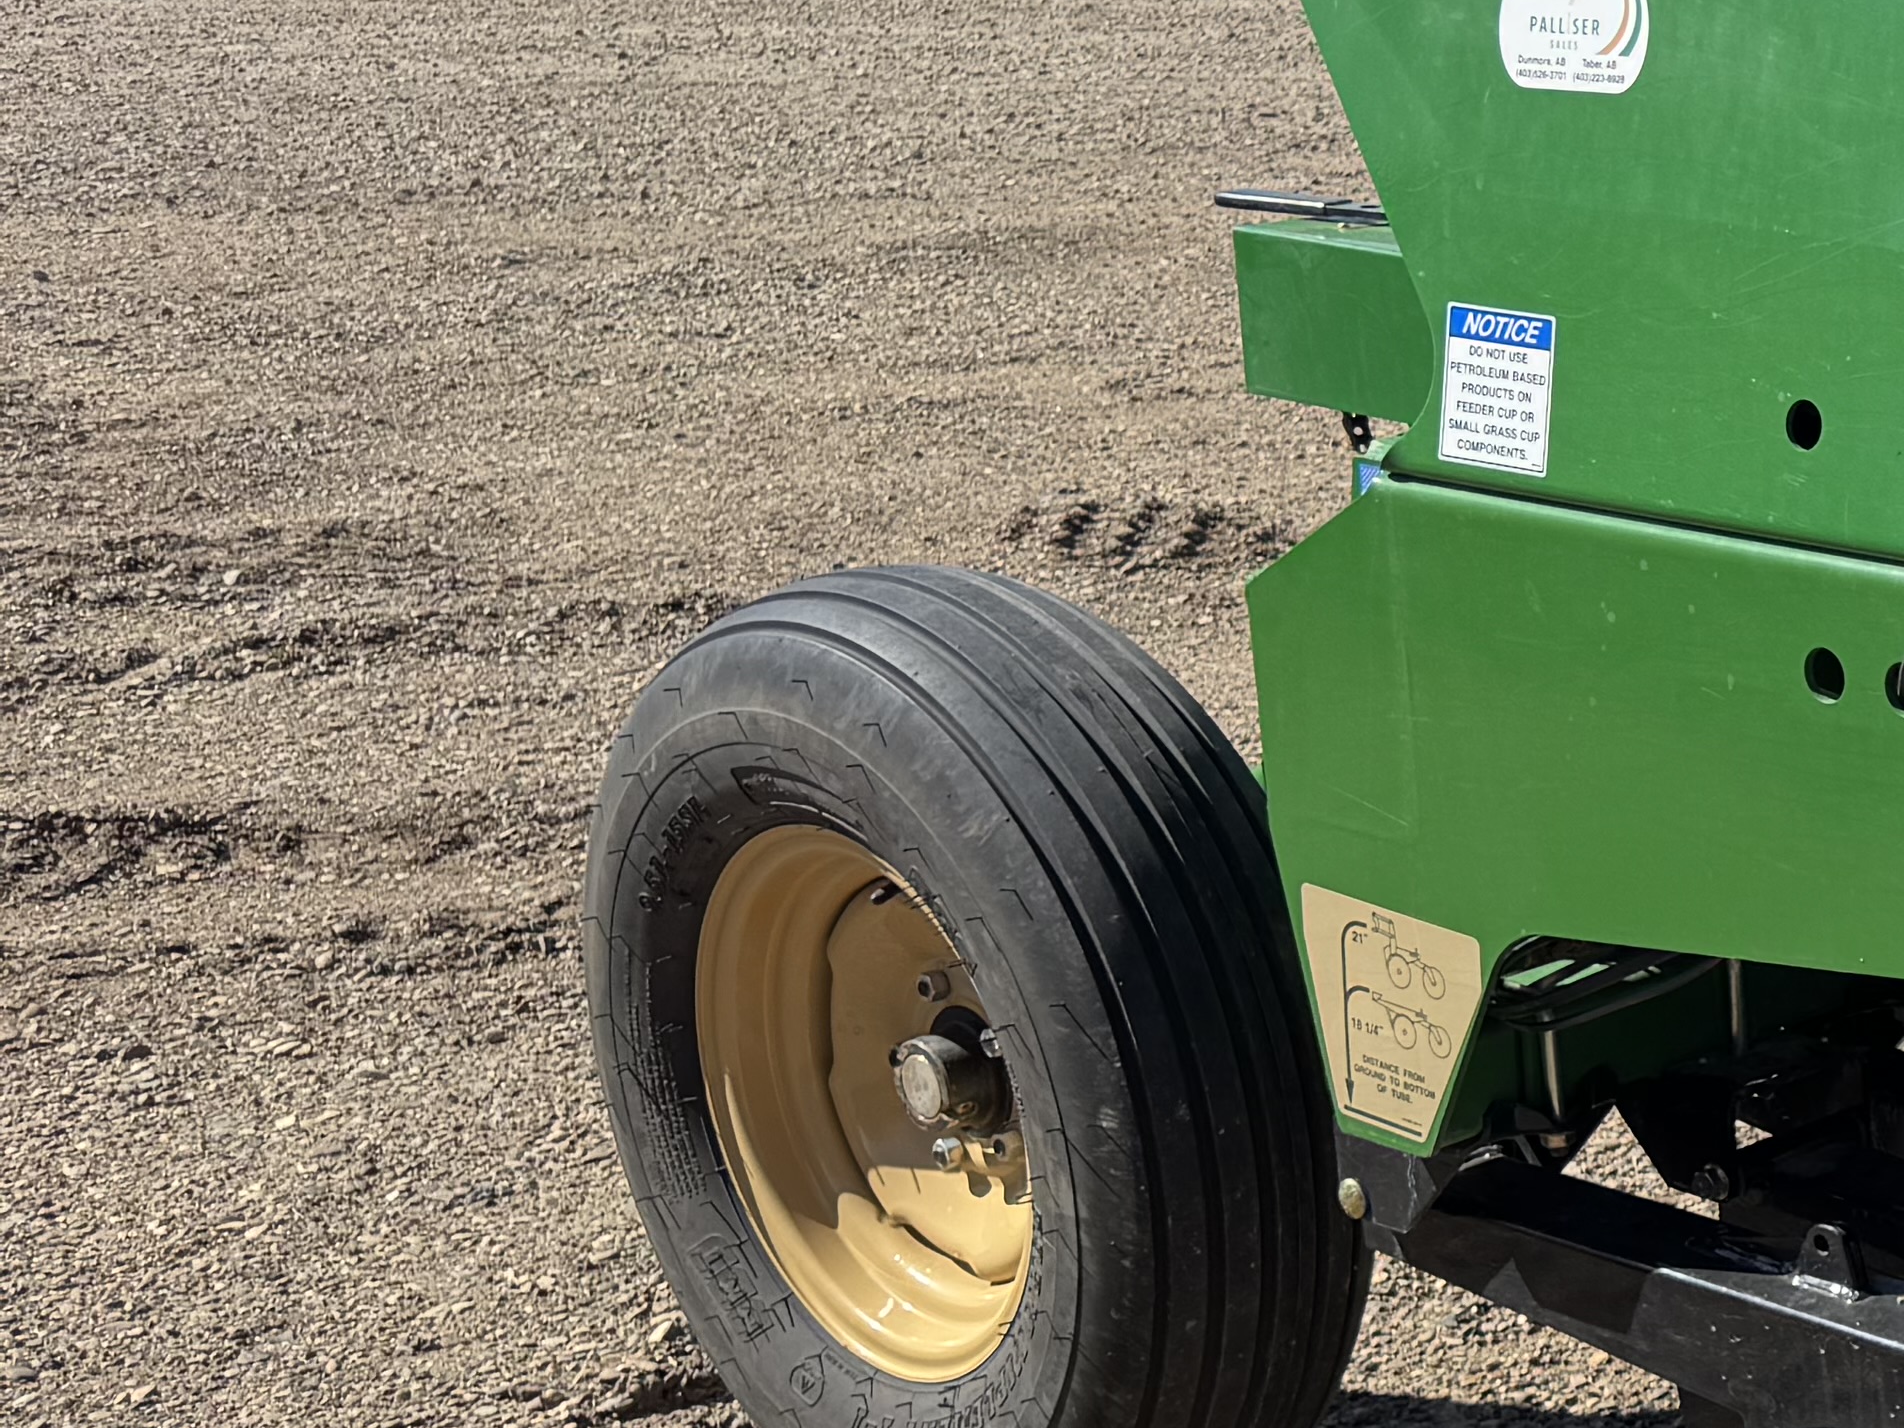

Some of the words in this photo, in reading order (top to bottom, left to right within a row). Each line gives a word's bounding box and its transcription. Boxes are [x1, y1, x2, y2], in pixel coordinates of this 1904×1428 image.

[1550, 39, 1578, 51] SALES
[1462, 311, 1543, 344] NOTICE
[1469, 345, 1483, 357] DO
[1486, 347, 1506, 361] NOT
[1509, 351, 1528, 364] USE
[1450, 361, 1510, 380] PETROLEUM
[1512, 370, 1546, 386] BASED
[1461, 382, 1515, 401] PRODUCTS
[1518, 390, 1532, 403] ON
[1456, 400, 1494, 417] FEEDER
[1497, 407, 1518, 420] CUP
[1520, 410, 1535, 423] OR
[1448, 418, 1480, 434] SMALL
[1483, 423, 1518, 439] GRASS
[1520, 430, 1541, 443] CUP
[1457, 438, 1529, 460] COMPONENTS.
[1389, 1075, 1400, 1087] TO
[1403, 1069, 1426, 1084] FROM
